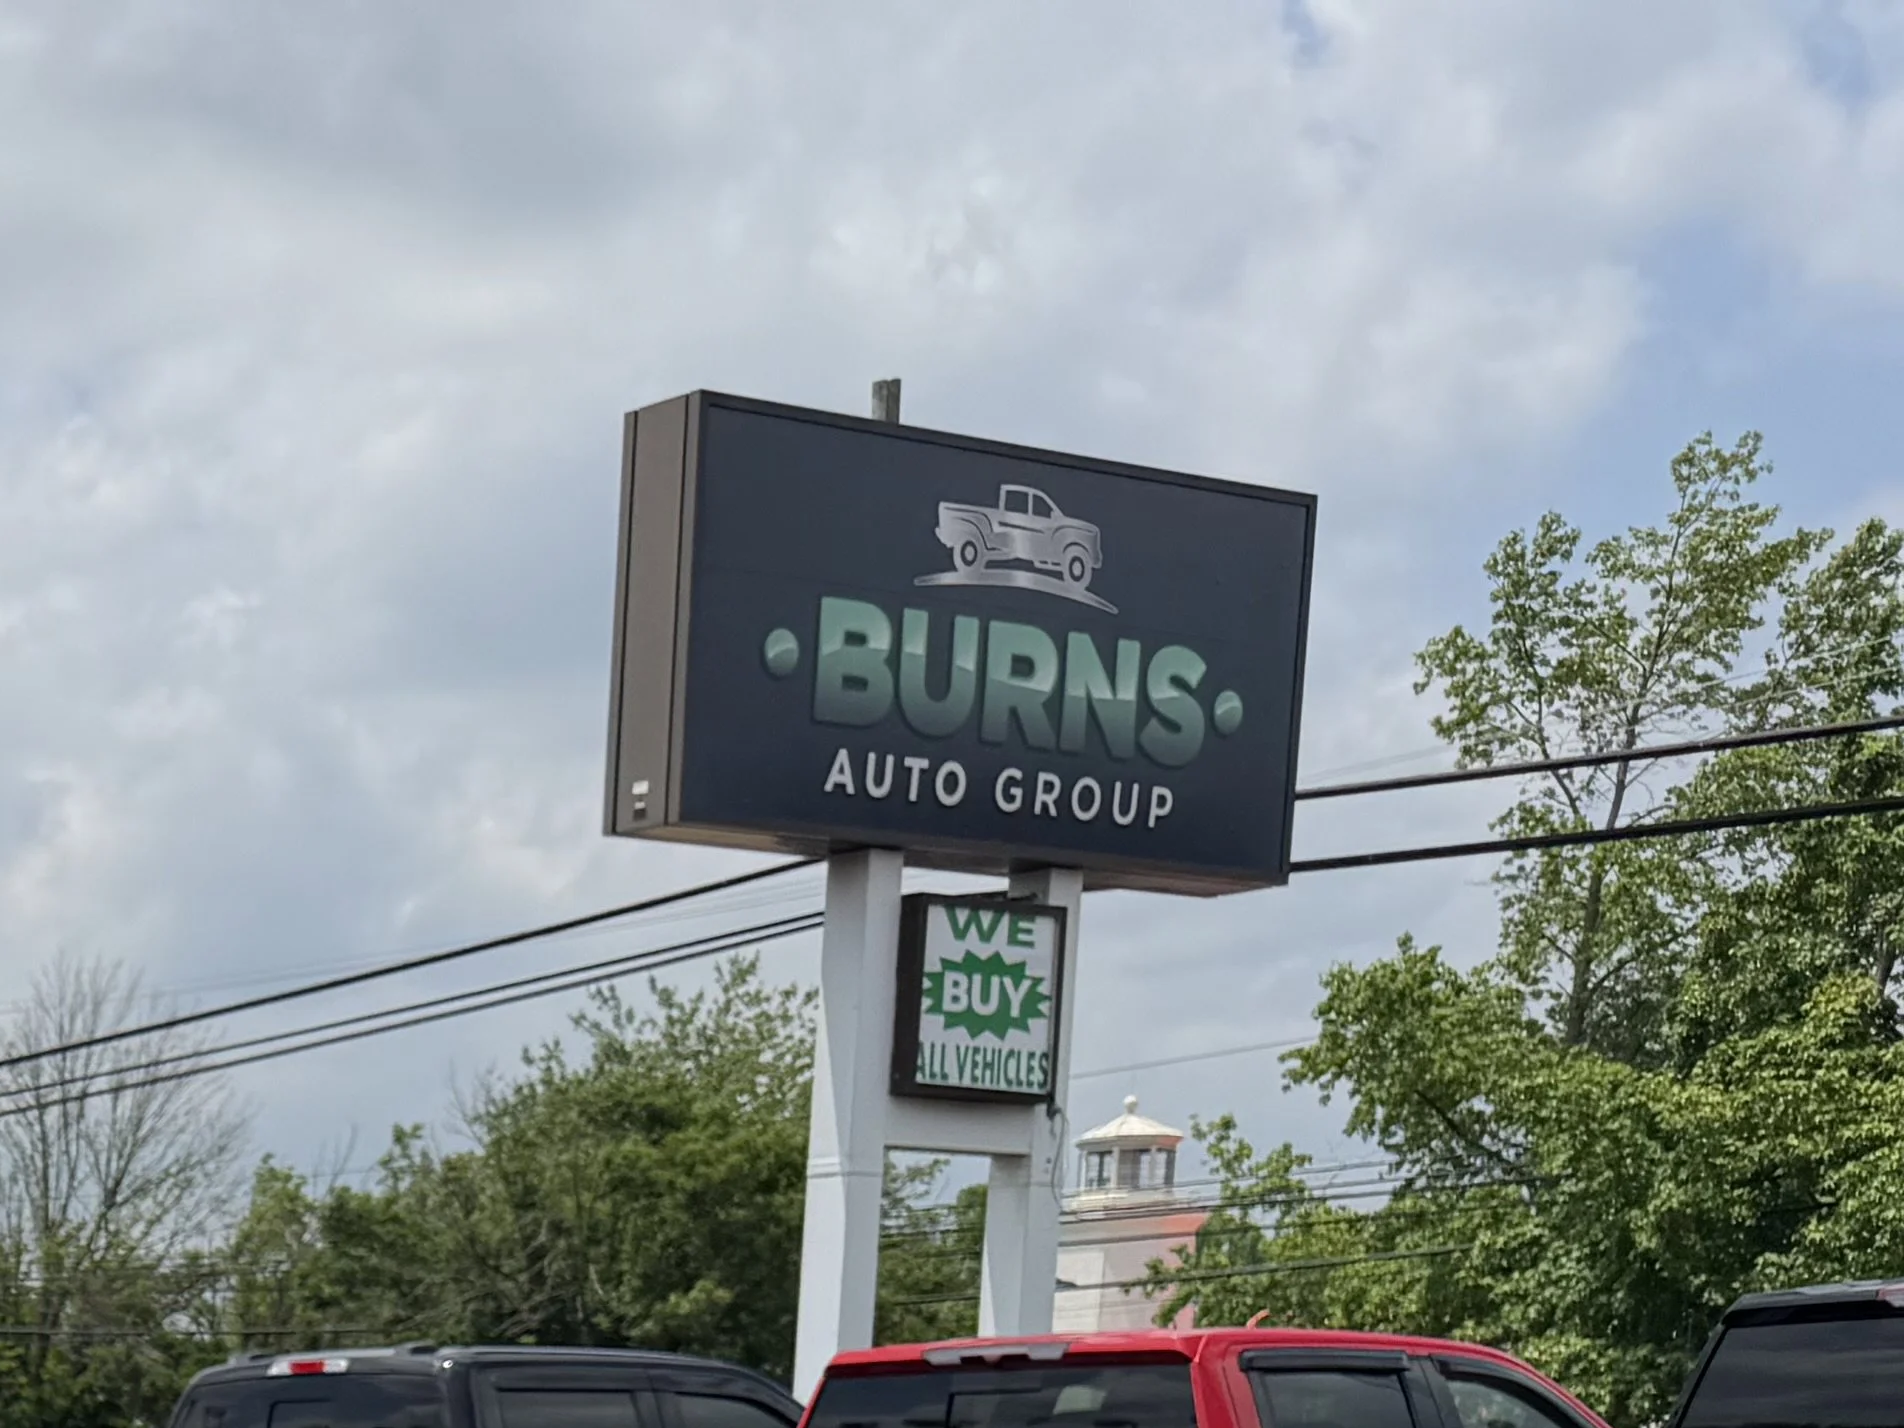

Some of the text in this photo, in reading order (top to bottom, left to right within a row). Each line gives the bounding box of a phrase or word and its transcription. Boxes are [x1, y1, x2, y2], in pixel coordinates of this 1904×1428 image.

[813, 596, 1208, 766] BURNS
[823, 747, 1175, 828] AUTO GROUP
[946, 906, 1037, 949] WE
[942, 972, 1031, 1017] BUY
[916, 1039, 1049, 1091] ALL VEHICLES
